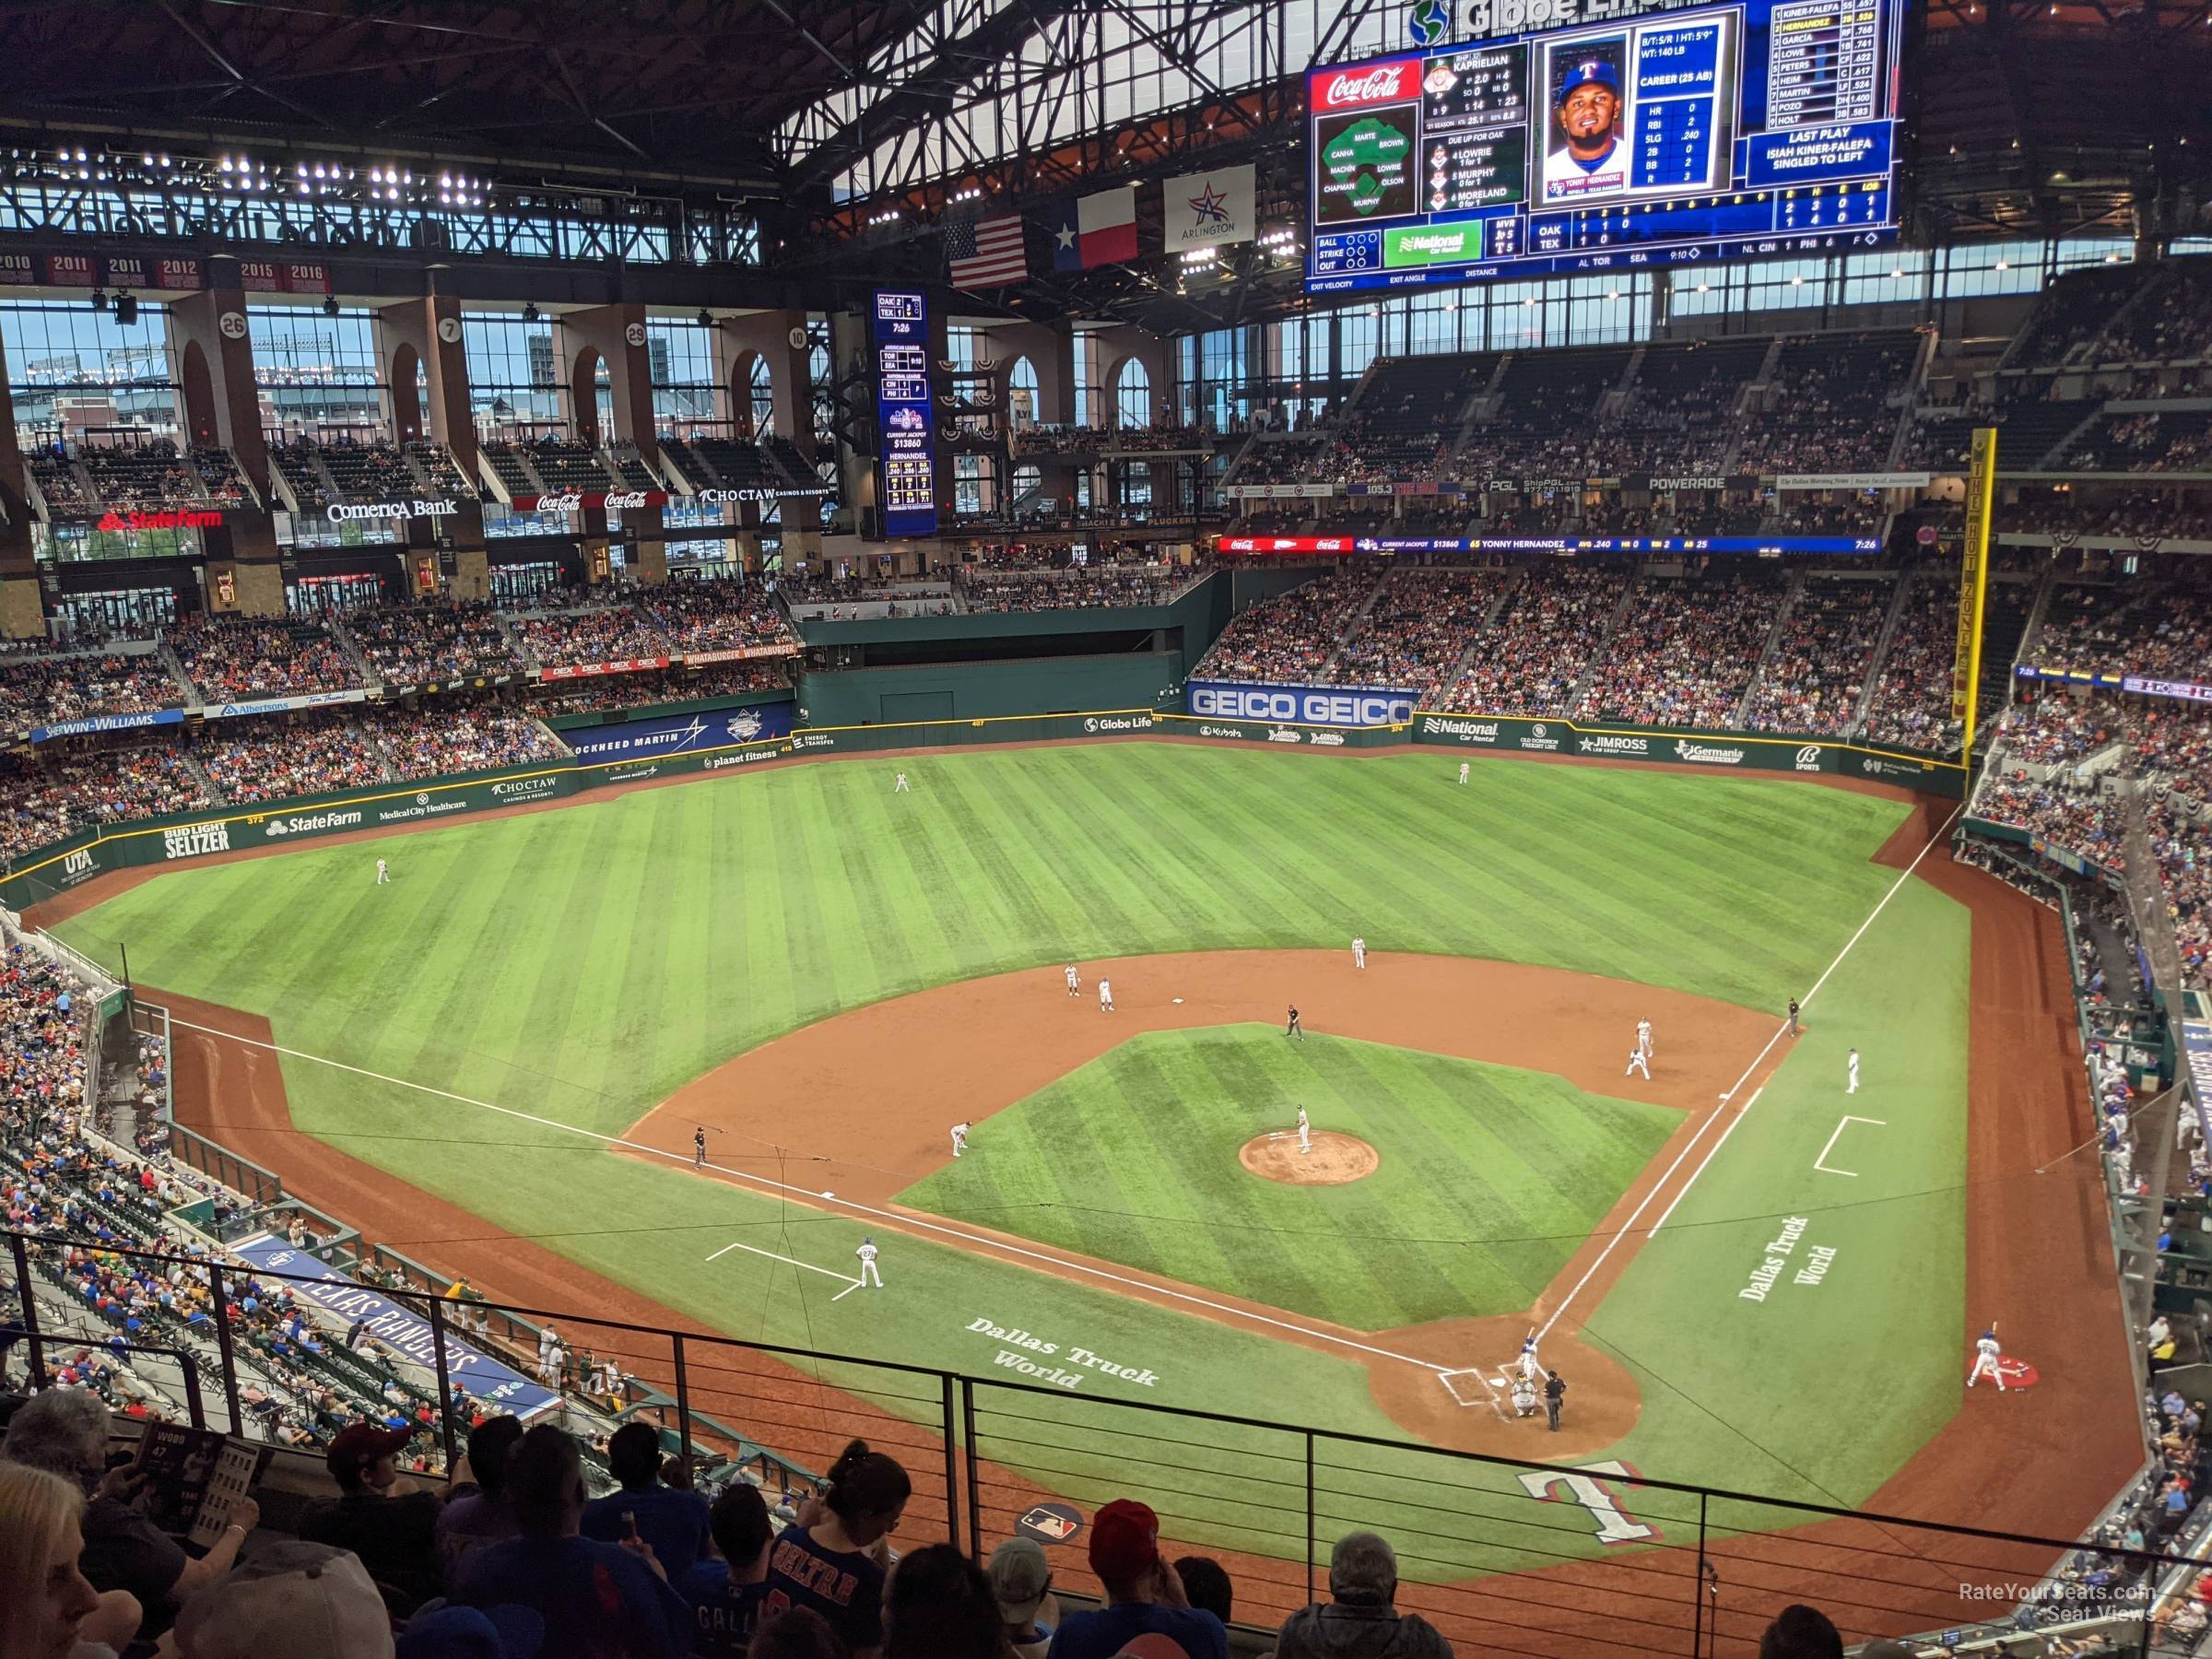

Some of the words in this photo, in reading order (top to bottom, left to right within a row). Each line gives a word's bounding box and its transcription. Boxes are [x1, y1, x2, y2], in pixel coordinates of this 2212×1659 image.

[1462, 0, 1580, 33] Globe
[1784, 3, 1840, 18] KINER-FALEFA
[1783, 18, 1830, 31] HERNANDEZ
[1659, 48, 1673, 57] 140
[1674, 46, 1685, 55] LB
[1782, 48, 1806, 58] LOWE
[1453, 55, 1508, 72] KAPRIELIAN
[1781, 61, 1809, 72] PETERS
[1327, 65, 1405, 105] Coca-Cola
[1641, 76, 1677, 87] CAREER
[1679, 74, 1692, 84] (25
[1696, 72, 1712, 82] AB)
[1780, 76, 1801, 85] HEIM
[1779, 88, 1810, 99] MARTIN
[1779, 101, 1802, 111] POZO
[1778, 116, 1799, 125] HOLT
[1355, 132, 1376, 142] MARTE
[1448, 135, 1461, 146] DUE
[1462, 135, 1472, 144] UP
[1473, 133, 1488, 142] FOR
[1488, 131, 1504, 140] OAK
[1789, 131, 1817, 144] LAST
[1819, 127, 1851, 140] PLAY
[1379, 139, 1404, 148] BROWN
[1767, 147, 1794, 159] ISIAH
[1797, 138, 1872, 156] KINER-FALEFA
[1331, 149, 1354, 159] CANHA
[1458, 147, 1492, 159] LOWRIE
[1773, 159, 1818, 170] SINGLED
[1820, 155, 1836, 164] TO
[1838, 151, 1864, 162] LEFT
[1377, 163, 1402, 172] LOWRIE
[1458, 168, 1495, 179] MURPHY
[1382, 177, 1404, 186] OLSON
[1324, 183, 1355, 194] CHAPMAN
[1458, 188, 1508, 200] MORELAND
[1353, 197, 1381, 207] MURPHY
[1182, 222, 1235, 241] ARLINGTON
[1539, 225, 1561, 236] OAK
[1320, 238, 1336, 247] BALL
[1413, 232, 1464, 251] National
[1540, 240, 1559, 249] TEX
[1320, 249, 1344, 258] STRIKE
[53, 256, 88, 272] 2011
[109, 258, 142, 274] 2011
[163, 260, 197, 275] 2012
[1320, 262, 1335, 271] OUT
[241, 264, 273, 278] 2015
[291, 265, 323, 279] 2016
[1311, 282, 1324, 290] EXIT
[1324, 280, 1353, 289] VELOCITY
[1465, 267, 1498, 277] DISTANCE
[879, 298, 894, 306] OAK
[223, 316, 245, 333] 26
[444, 322, 455, 339] 7
[893, 323, 911, 333] 7:26
[628, 326, 644, 343] 29
[791, 330, 806, 346] 10
[894, 439, 922, 448] $13860
[1367, 485, 1392, 494] 105.3
[1489, 481, 1517, 491] PGL
[1650, 477, 1725, 490] POWERADE
[605, 492, 647, 509] Coca-Cola
[707, 488, 774, 501] CHOCTAW
[414, 499, 458, 516] Bank
[536, 494, 582, 512] Coca-Cola
[1147, 516, 1197, 525] PLUCKERS
[1513, 540, 1565, 548] HERNANDEZ
[1855, 540, 1877, 549] 7:26
[687, 651, 739, 664] WHATABURGER
[745, 645, 794, 658] WHATABURGER
[582, 664, 603, 673] DEX
[610, 661, 630, 669] DEX
[638, 658, 658, 666] DEX
[553, 665, 573, 676] DEX
[306, 695, 322, 704] Tom
[324, 692, 347, 702] Thumb
[1193, 689, 1296, 719] GEICO
[240, 701, 288, 714] Albertsons
[1303, 695, 1413, 724] GEICO
[1100, 718, 1131, 730] Globe
[1133, 716, 1152, 727] Life
[1440, 720, 1499, 736] National
[1213, 726, 1242, 737] Kubota
[571, 740, 629, 756] OCKHEED
[634, 734, 678, 747] MARTIN
[805, 739, 834, 747] TRANSFER
[1473, 735, 1495, 743] Rental
[1693, 746, 1743, 758] Germania
[713, 756, 743, 769] planet
[746, 750, 777, 761] fitness
[497, 778, 557, 794] CHOCTAW
[380, 807, 409, 820] Medical
[411, 806, 426, 817] City
[426, 800, 466, 815] Healthcare
[247, 817, 264, 825] 372
[164, 828, 190, 839] BUD
[191, 822, 227, 835] LIGHT
[165, 830, 229, 859] SELTZER
[65, 850, 92, 874] UTA
[1738, 1256, 1784, 1302] Dallas
[1764, 1217, 1808, 1255] Truck
[1794, 1245, 1837, 1285] World
[300, 1272, 380, 1316] TEXAS
[367, 1310, 478, 1374] RANGERS
[966, 1317, 1060, 1354] Dallas
[1065, 1347, 1159, 1386] Truck
[994, 1350, 1084, 1388] World
[1517, 1460, 1664, 1547] T
